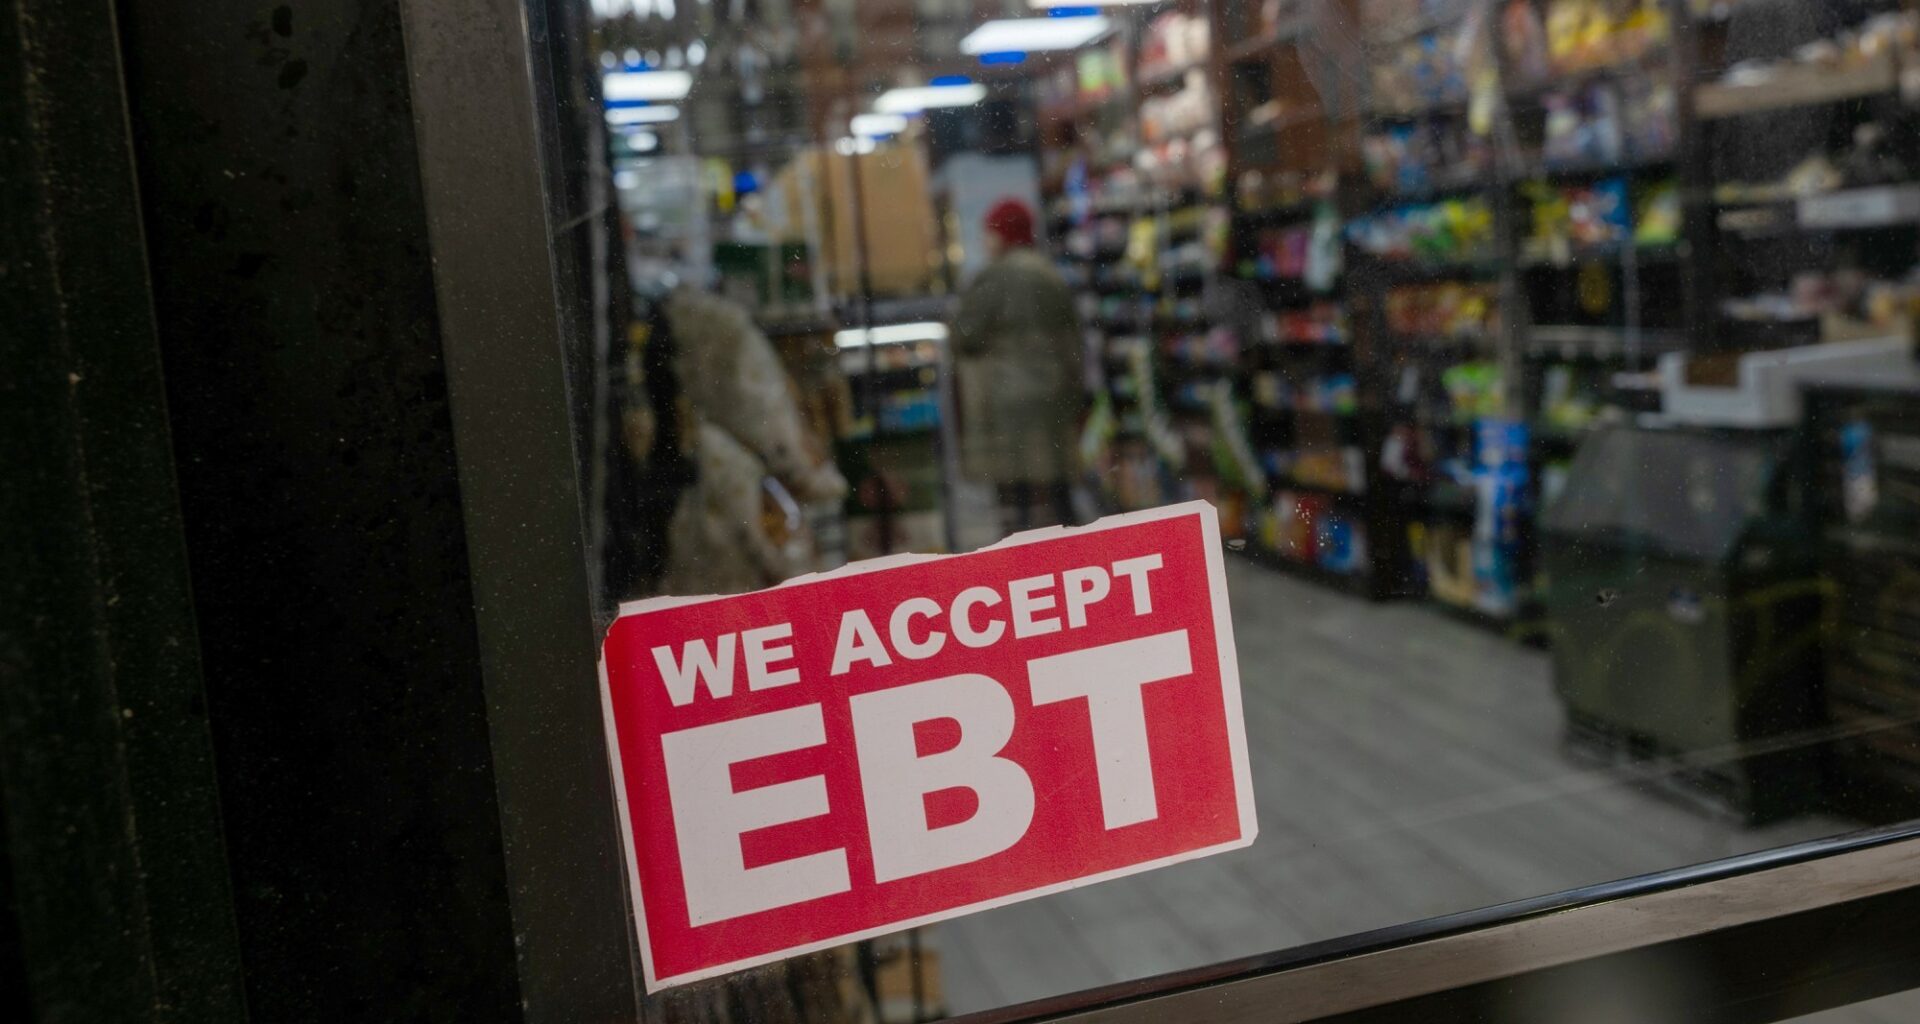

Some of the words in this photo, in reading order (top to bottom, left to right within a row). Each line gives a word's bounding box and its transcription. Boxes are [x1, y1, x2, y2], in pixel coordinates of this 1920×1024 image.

[651, 623, 800, 707] WE
[830, 553, 1163, 676] ACCEPT
[660, 629, 1193, 928] EBT
